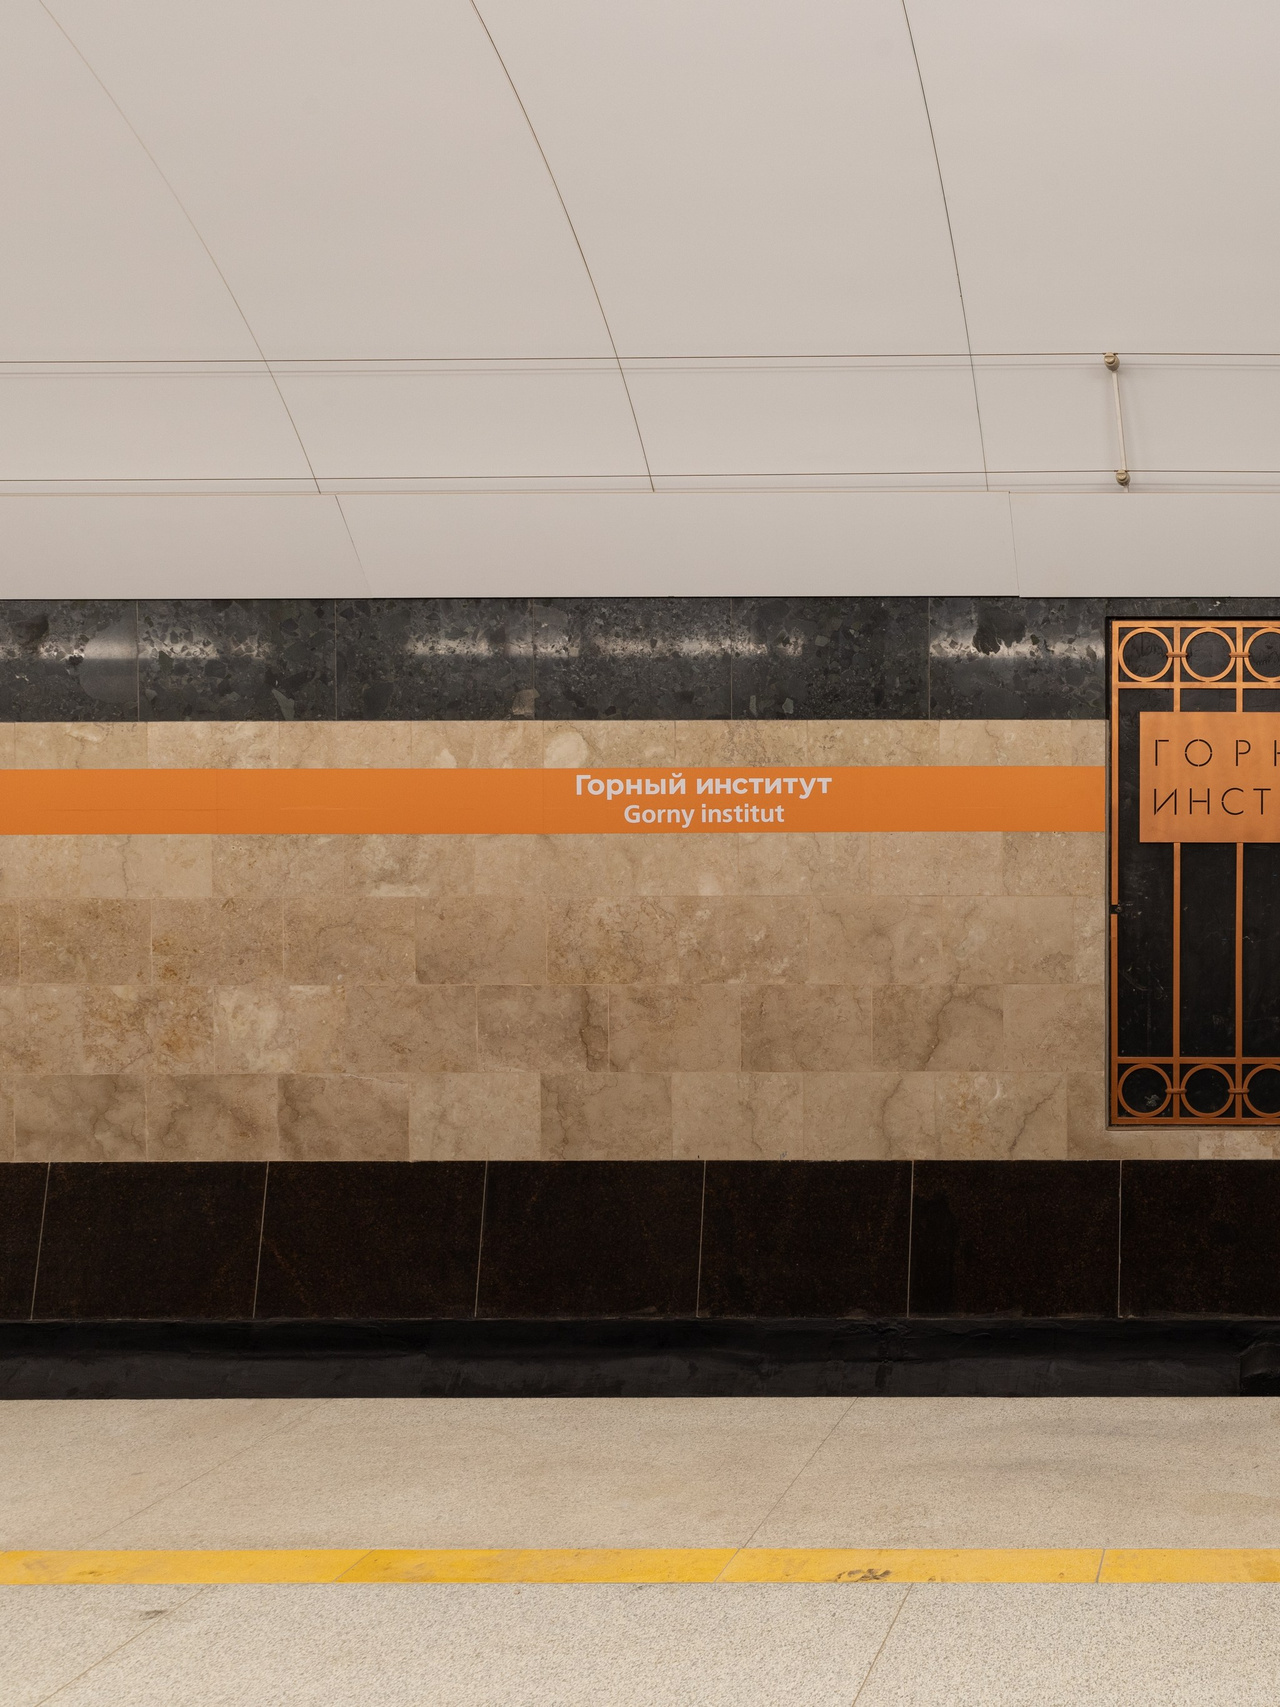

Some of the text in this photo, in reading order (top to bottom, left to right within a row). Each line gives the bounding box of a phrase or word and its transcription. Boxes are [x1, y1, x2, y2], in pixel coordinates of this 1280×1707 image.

[576, 772, 832, 800] Горный институт
[623, 803, 785, 829] Gorny institut
